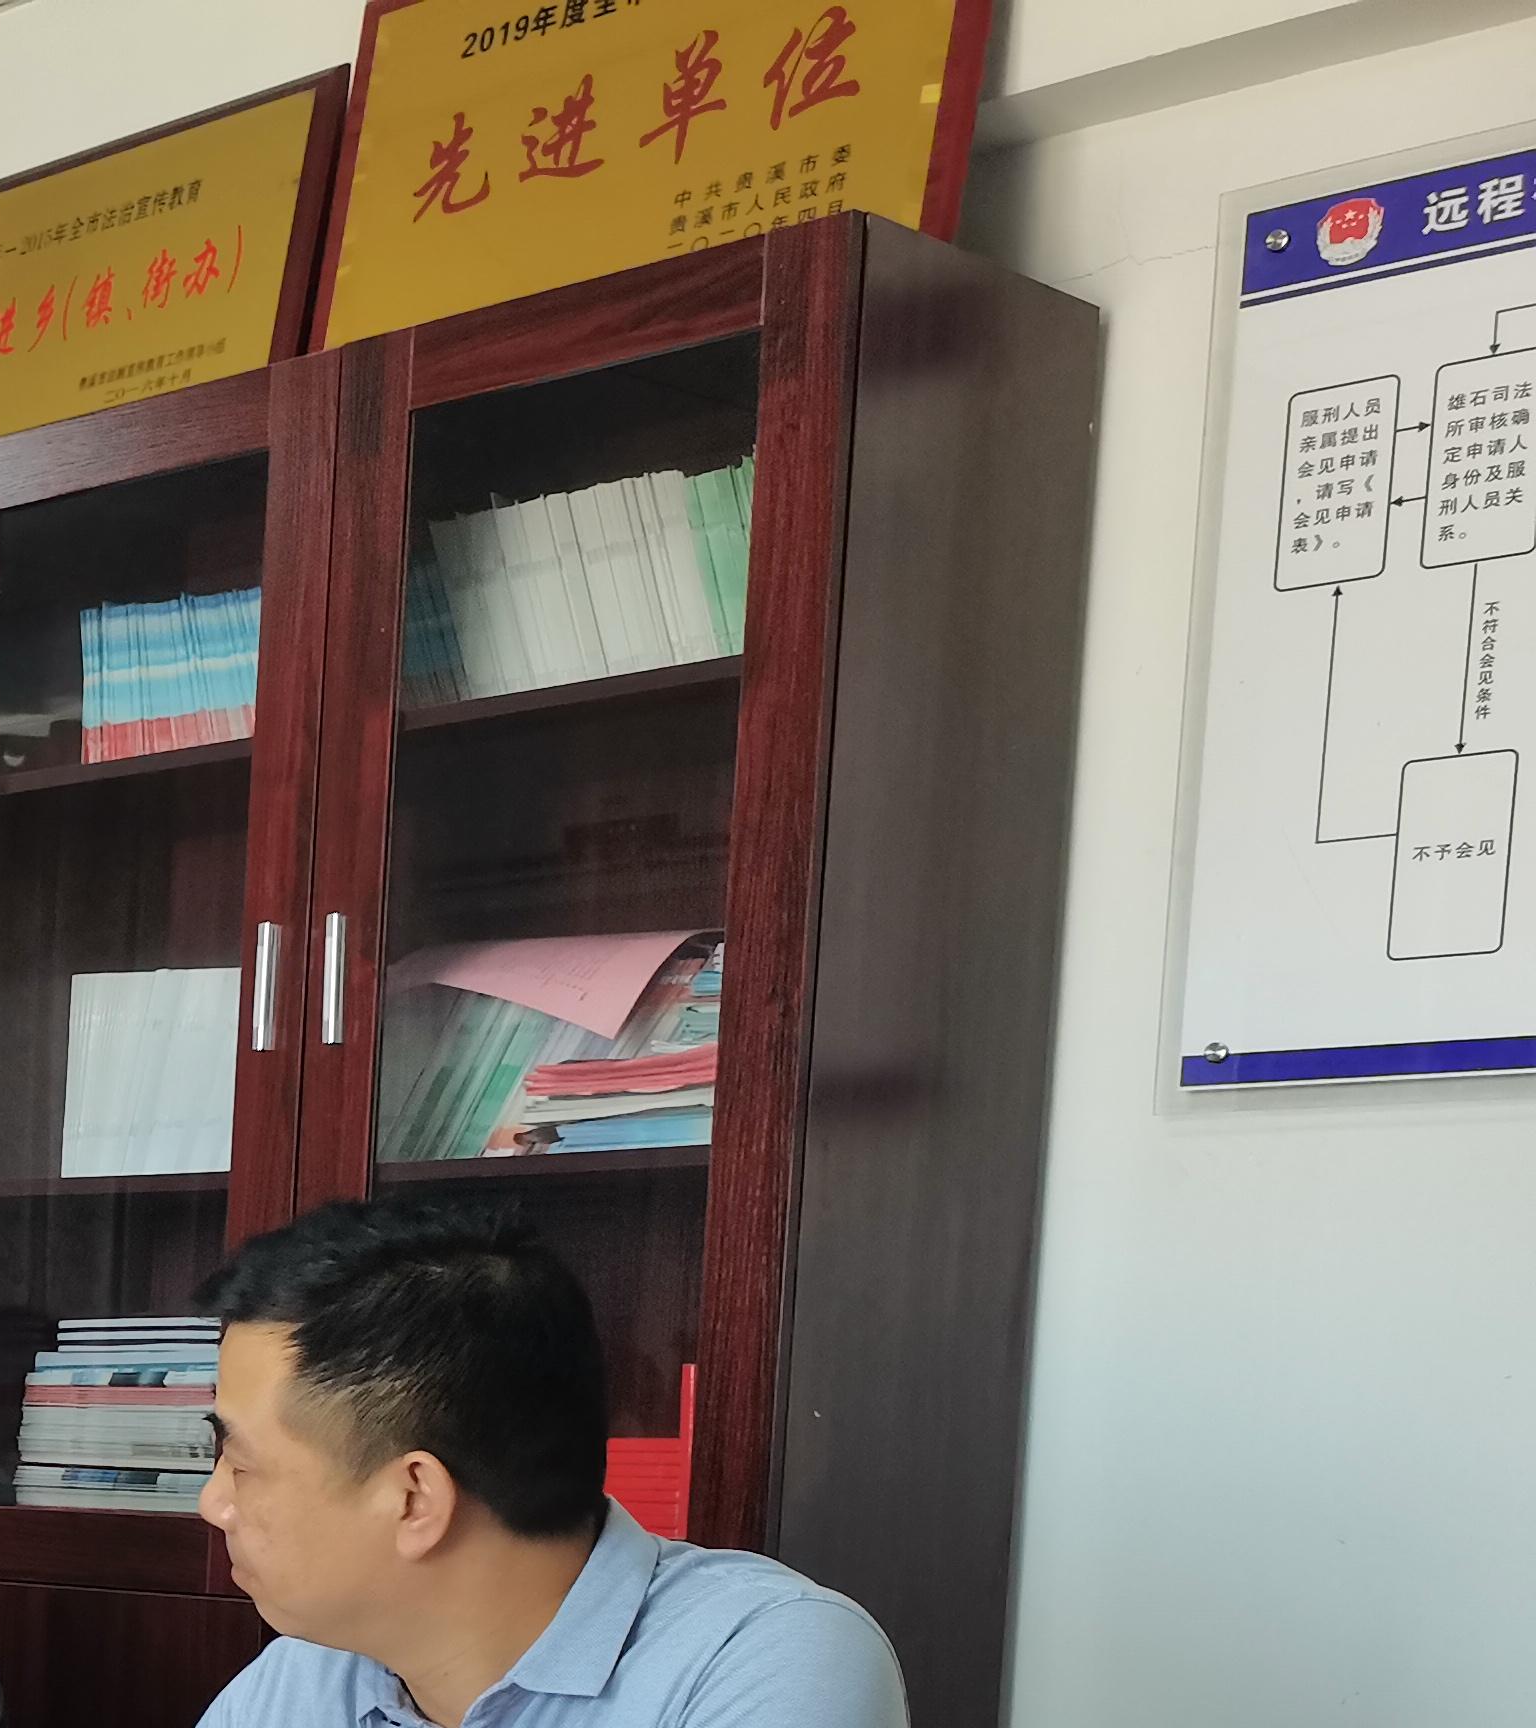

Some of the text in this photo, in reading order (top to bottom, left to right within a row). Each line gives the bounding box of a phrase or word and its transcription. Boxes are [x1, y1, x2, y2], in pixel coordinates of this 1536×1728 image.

[412, 6, 861, 223] 先进单位
[674, 143, 852, 208] 中共贵溪市委
[669, 172, 847, 236] 贵溪市人民政府
[1421, 173, 1536, 236] 远程
[1447, 381, 1533, 411] 雄石司法
[1301, 398, 1382, 428] 服刑人员
[1445, 408, 1531, 439] 所审核确
[1299, 424, 1379, 453] 亲属提出
[1442, 434, 1529, 465] 定申请人
[1297, 449, 1378, 479] 会见申请
[1441, 460, 1526, 491] 身份及服
[1293, 500, 1375, 530] 会见申请
[1438, 487, 1524, 517] 刑人员关
[1438, 523, 1468, 542] 系。
[1474, 600, 1502, 721] 不符合会见条件
[1412, 838, 1497, 862] 不予会见
